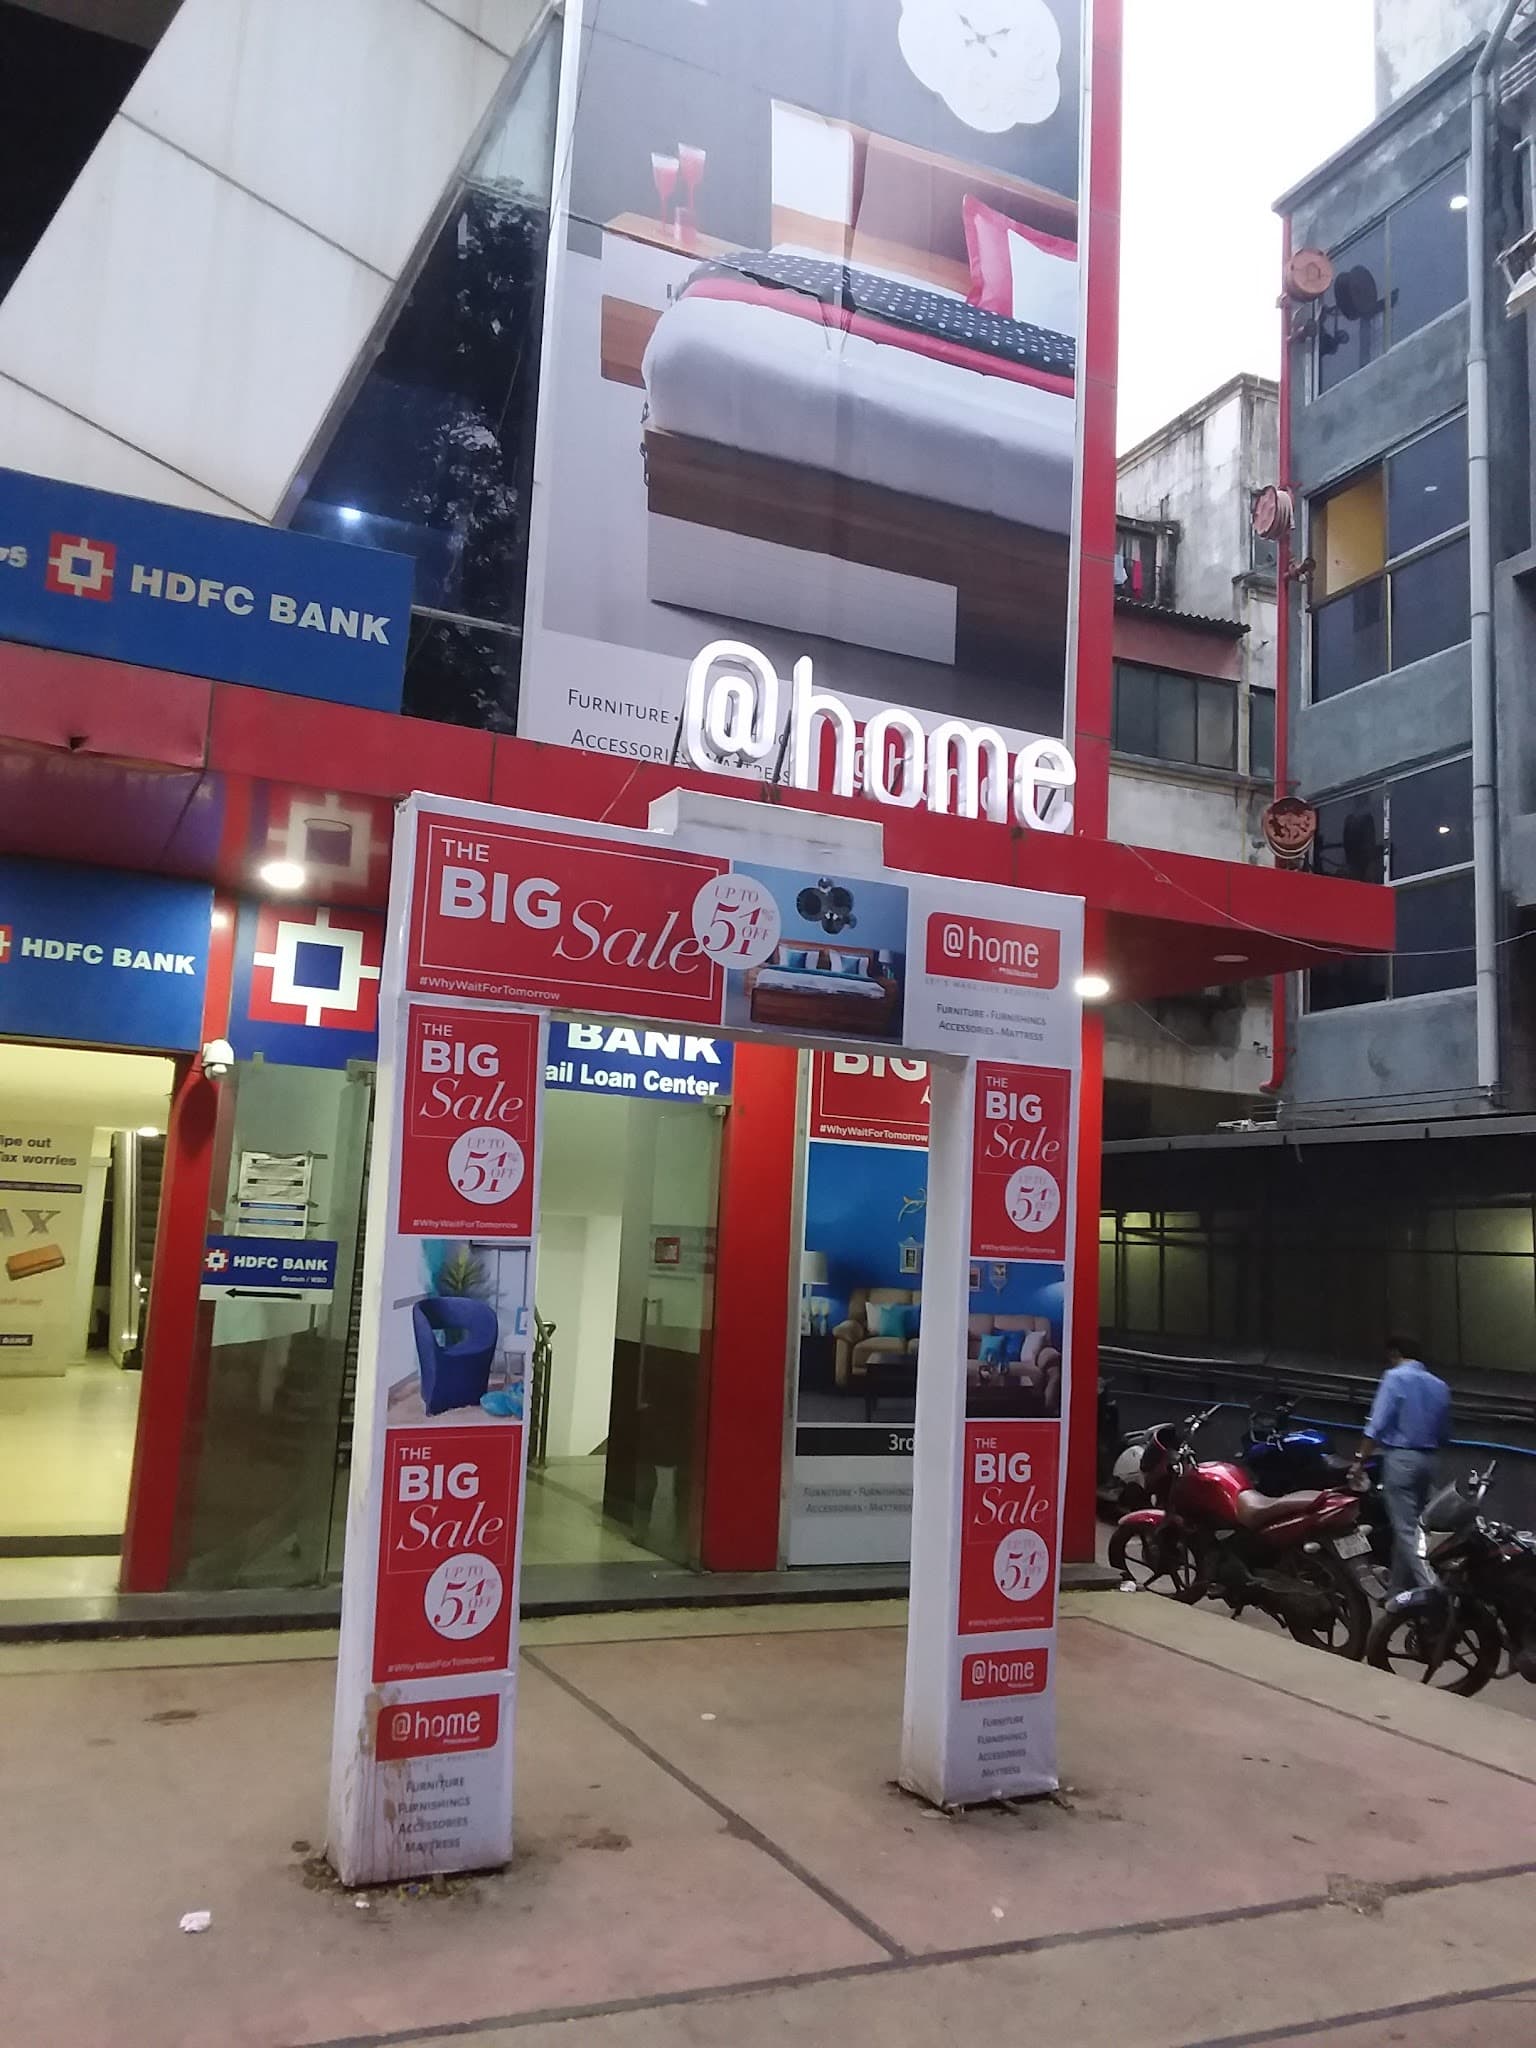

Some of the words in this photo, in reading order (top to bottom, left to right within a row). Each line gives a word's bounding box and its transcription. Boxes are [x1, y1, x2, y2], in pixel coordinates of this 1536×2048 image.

[130, 564, 254, 616] HDFC
[269, 593, 391, 645] BANK
[683, 640, 1077, 834] @home
[441, 838, 490, 863] THE
[715, 885, 736, 899] UP
[740, 890, 759, 902] TO
[439, 866, 562, 930] BIG
[552, 900, 704, 974] Sale
[21, 937, 104, 965] HDFC
[112, 948, 196, 976] BANK
[943, 923, 1039, 968] @home
[419, 976, 561, 1001] #WhyWaitForTomorrow
[422, 1022, 453, 1037] THE
[568, 1023, 721, 1064] BANK
[421, 1040, 499, 1078] BIG
[833, 1052, 927, 1081] BIG
[580, 1067, 636, 1089] Loan
[643, 1070, 719, 1097] Center
[985, 1076, 1008, 1089] THE
[419, 1077, 524, 1122] Sale
[985, 1091, 1042, 1123] BIG
[27, 1138, 51, 1148] out
[820, 1124, 929, 1142] #WhyWaitForTomorrow
[985, 1122, 1060, 1162] Sale
[23, 1155, 77, 1166] worries
[233, 1255, 278, 1269] HDFC
[282, 1257, 328, 1271] BANK
[400, 1447, 432, 1460] THE
[974, 1437, 998, 1449] THE
[399, 1462, 479, 1502] BIG
[974, 1452, 1032, 1484] BIG
[974, 1485, 1049, 1525] Sale
[396, 1501, 503, 1550] Sale
[971, 1659, 1035, 1686] @home
[391, 1711, 480, 1741] @home
